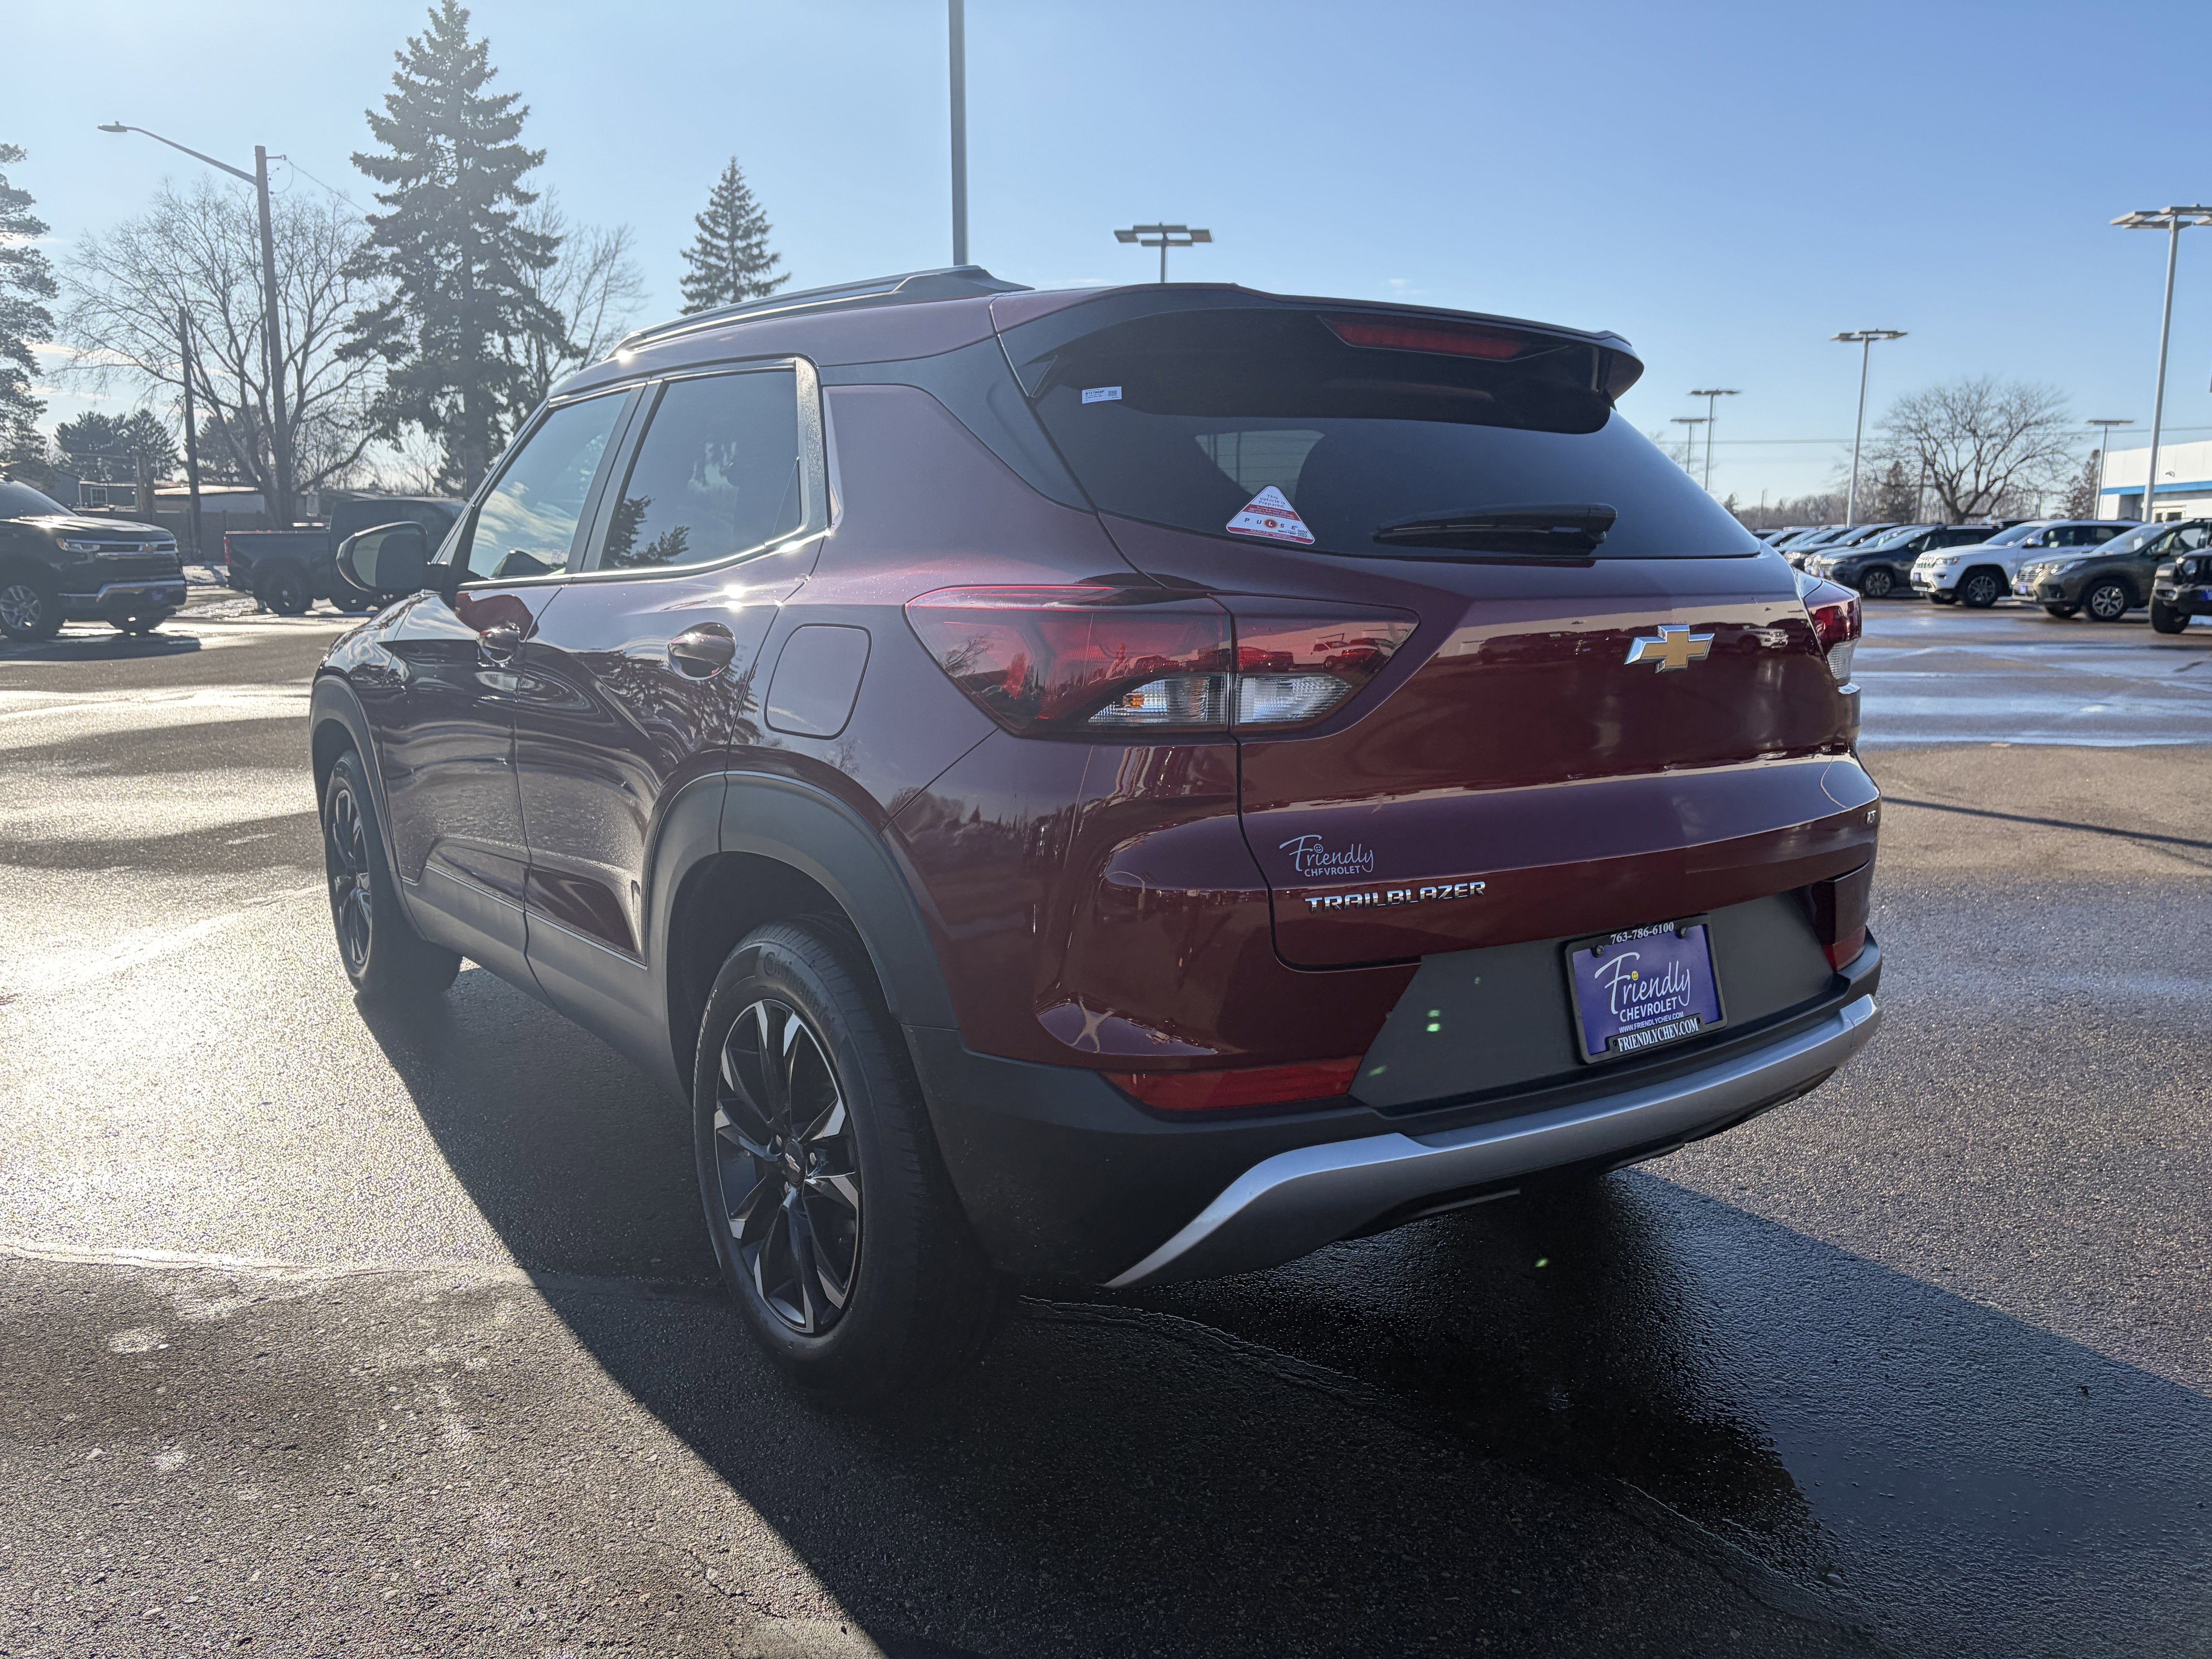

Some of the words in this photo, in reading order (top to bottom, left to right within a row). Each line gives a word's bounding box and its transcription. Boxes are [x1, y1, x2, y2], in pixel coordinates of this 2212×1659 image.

[1244, 518, 1298, 531] PULSE
[1279, 835, 1374, 872] Friendly
[1304, 881, 1486, 914] TRAILBLAZER
[1611, 921, 1674, 944] 763-786-6100
[1594, 952, 1691, 1015] Friendly
[1619, 1011, 1684, 1034] WWW.FRIENDLYCHEV.COM
[1620, 996, 1678, 1022] CHEVROLET
[1617, 1017, 1699, 1053] FRIENDLYCHEV.COM
